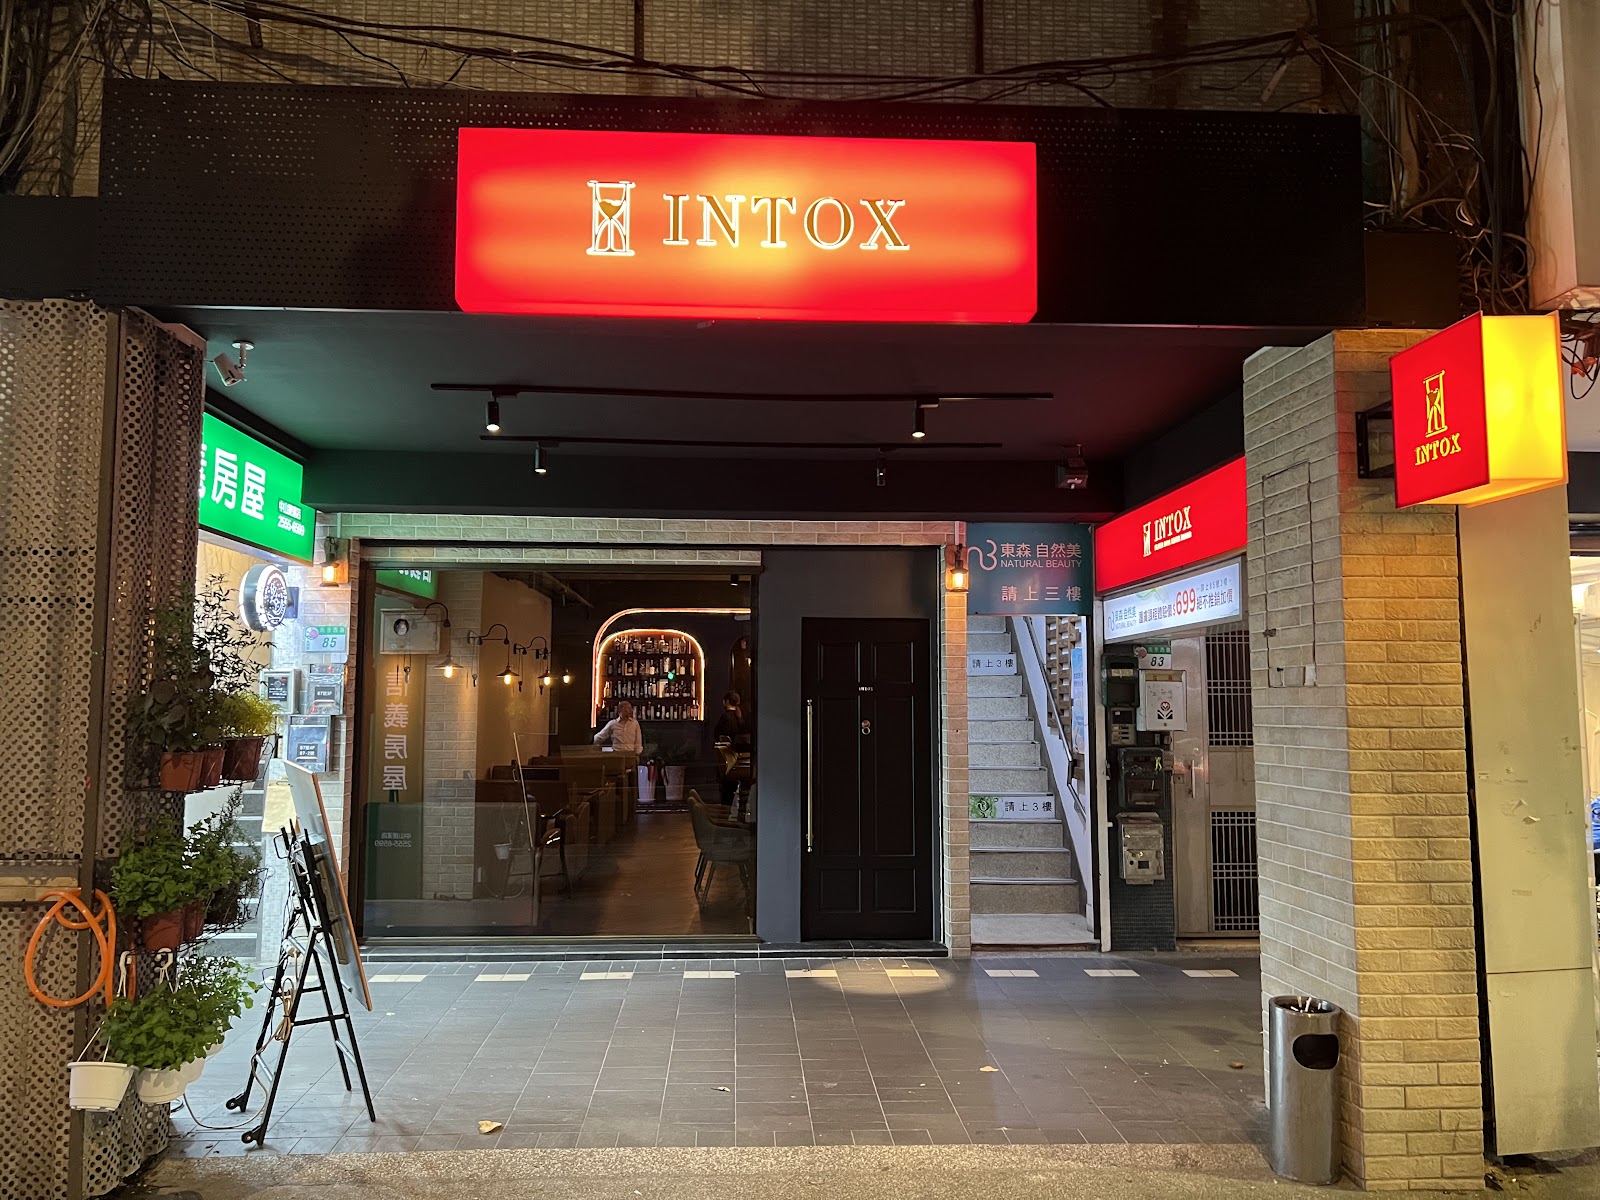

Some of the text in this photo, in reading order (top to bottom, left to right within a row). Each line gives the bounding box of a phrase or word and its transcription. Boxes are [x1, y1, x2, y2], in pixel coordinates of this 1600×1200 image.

[663, 194, 910, 250] INTOX
[1415, 433, 1461, 465] INTOX
[199, 443, 266, 521] 房屋
[1154, 506, 1192, 542] INTOX
[1001, 542, 1082, 558] 東森 自然美
[1000, 559, 1082, 568] NATURAL BEAUTY
[1001, 586, 1082, 601] 請上三樓
[322, 637, 337, 648] 85
[972, 659, 1014, 669] 請上3樓
[1151, 656, 1165, 667] 83
[1005, 801, 1052, 812] 請上3樓
